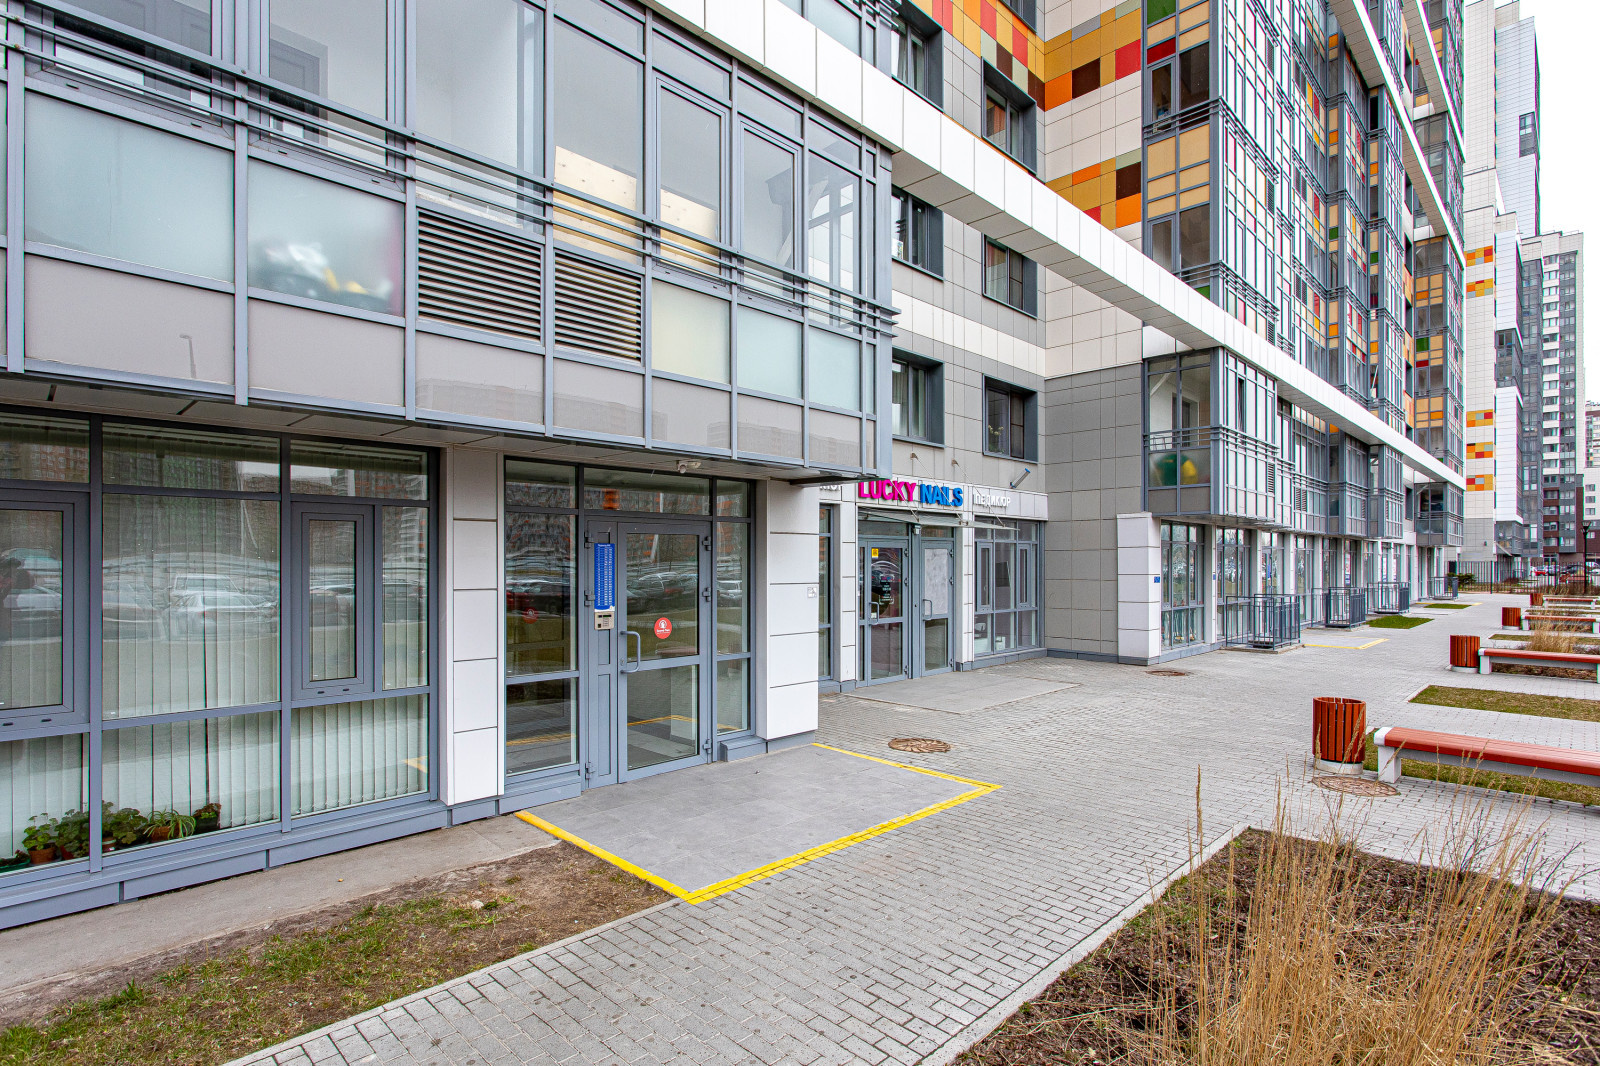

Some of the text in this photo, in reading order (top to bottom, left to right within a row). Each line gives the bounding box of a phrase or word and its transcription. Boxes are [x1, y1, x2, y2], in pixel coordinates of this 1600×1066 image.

[858, 479, 963, 507] LUCKY NAILS
[974, 493, 1011, 507] ПЕДИКЮР
